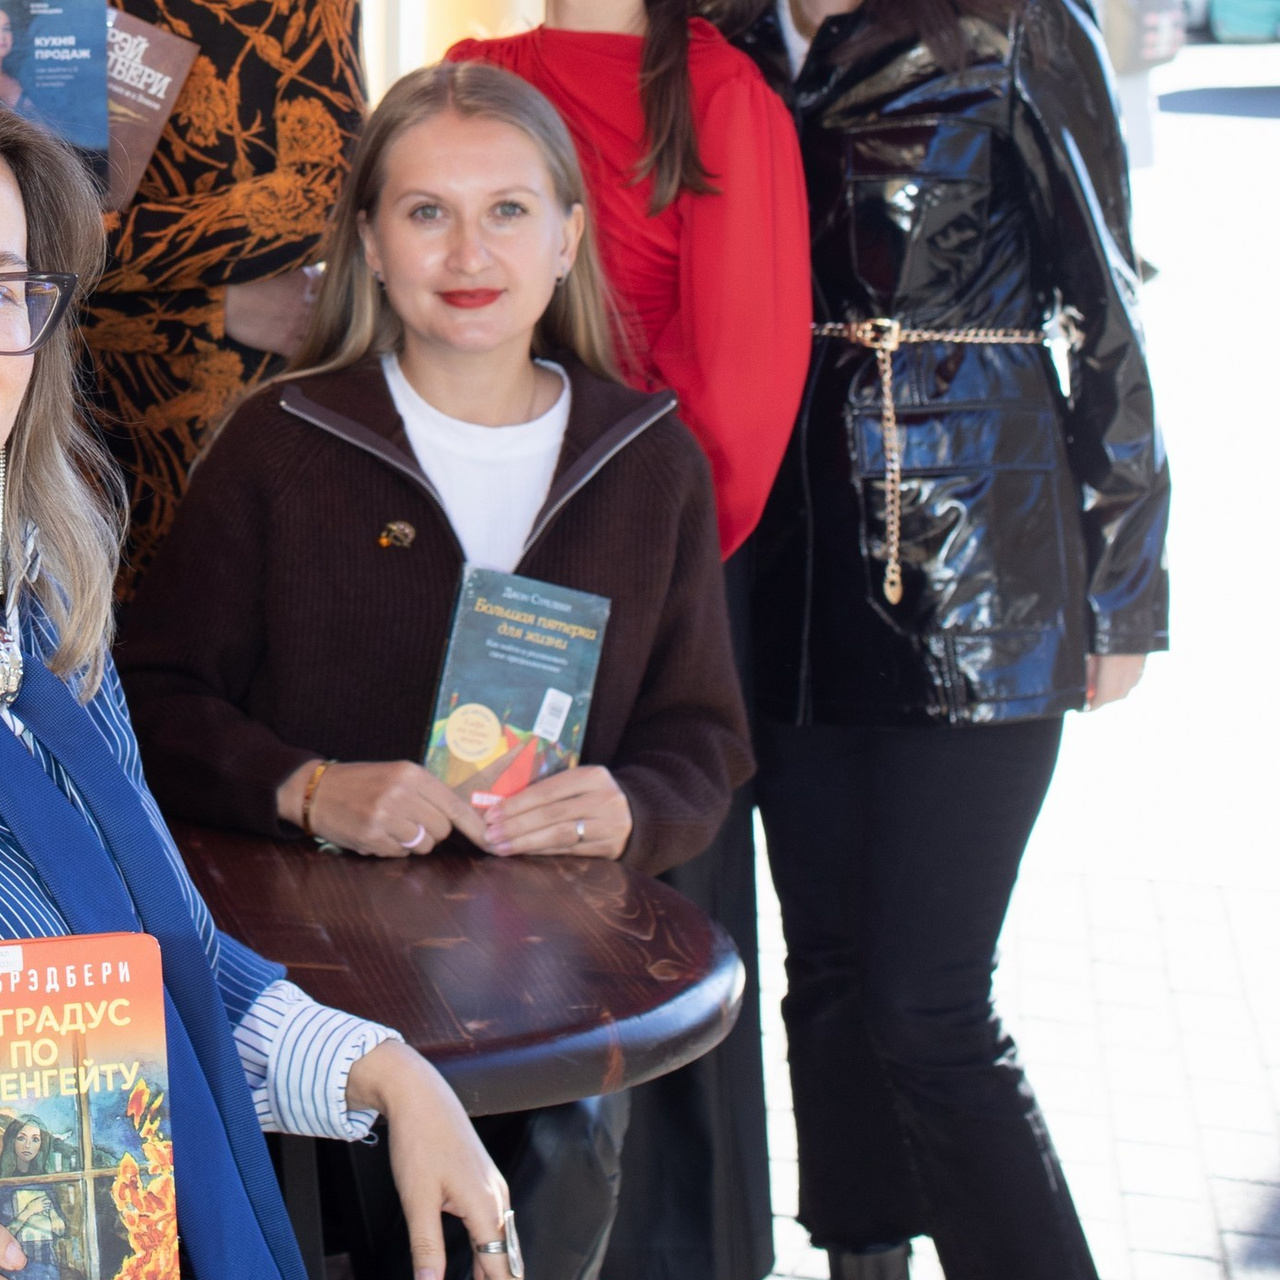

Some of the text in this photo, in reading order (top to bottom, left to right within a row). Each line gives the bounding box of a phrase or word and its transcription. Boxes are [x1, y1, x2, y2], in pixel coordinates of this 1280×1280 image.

[33, 35, 76, 47] КУХНЯ
[34, 49, 91, 61] ПРОДАЖ
[474, 597, 536, 625] Большая
[497, 622, 524, 639] для
[10, 1037, 59, 1069] ПО
